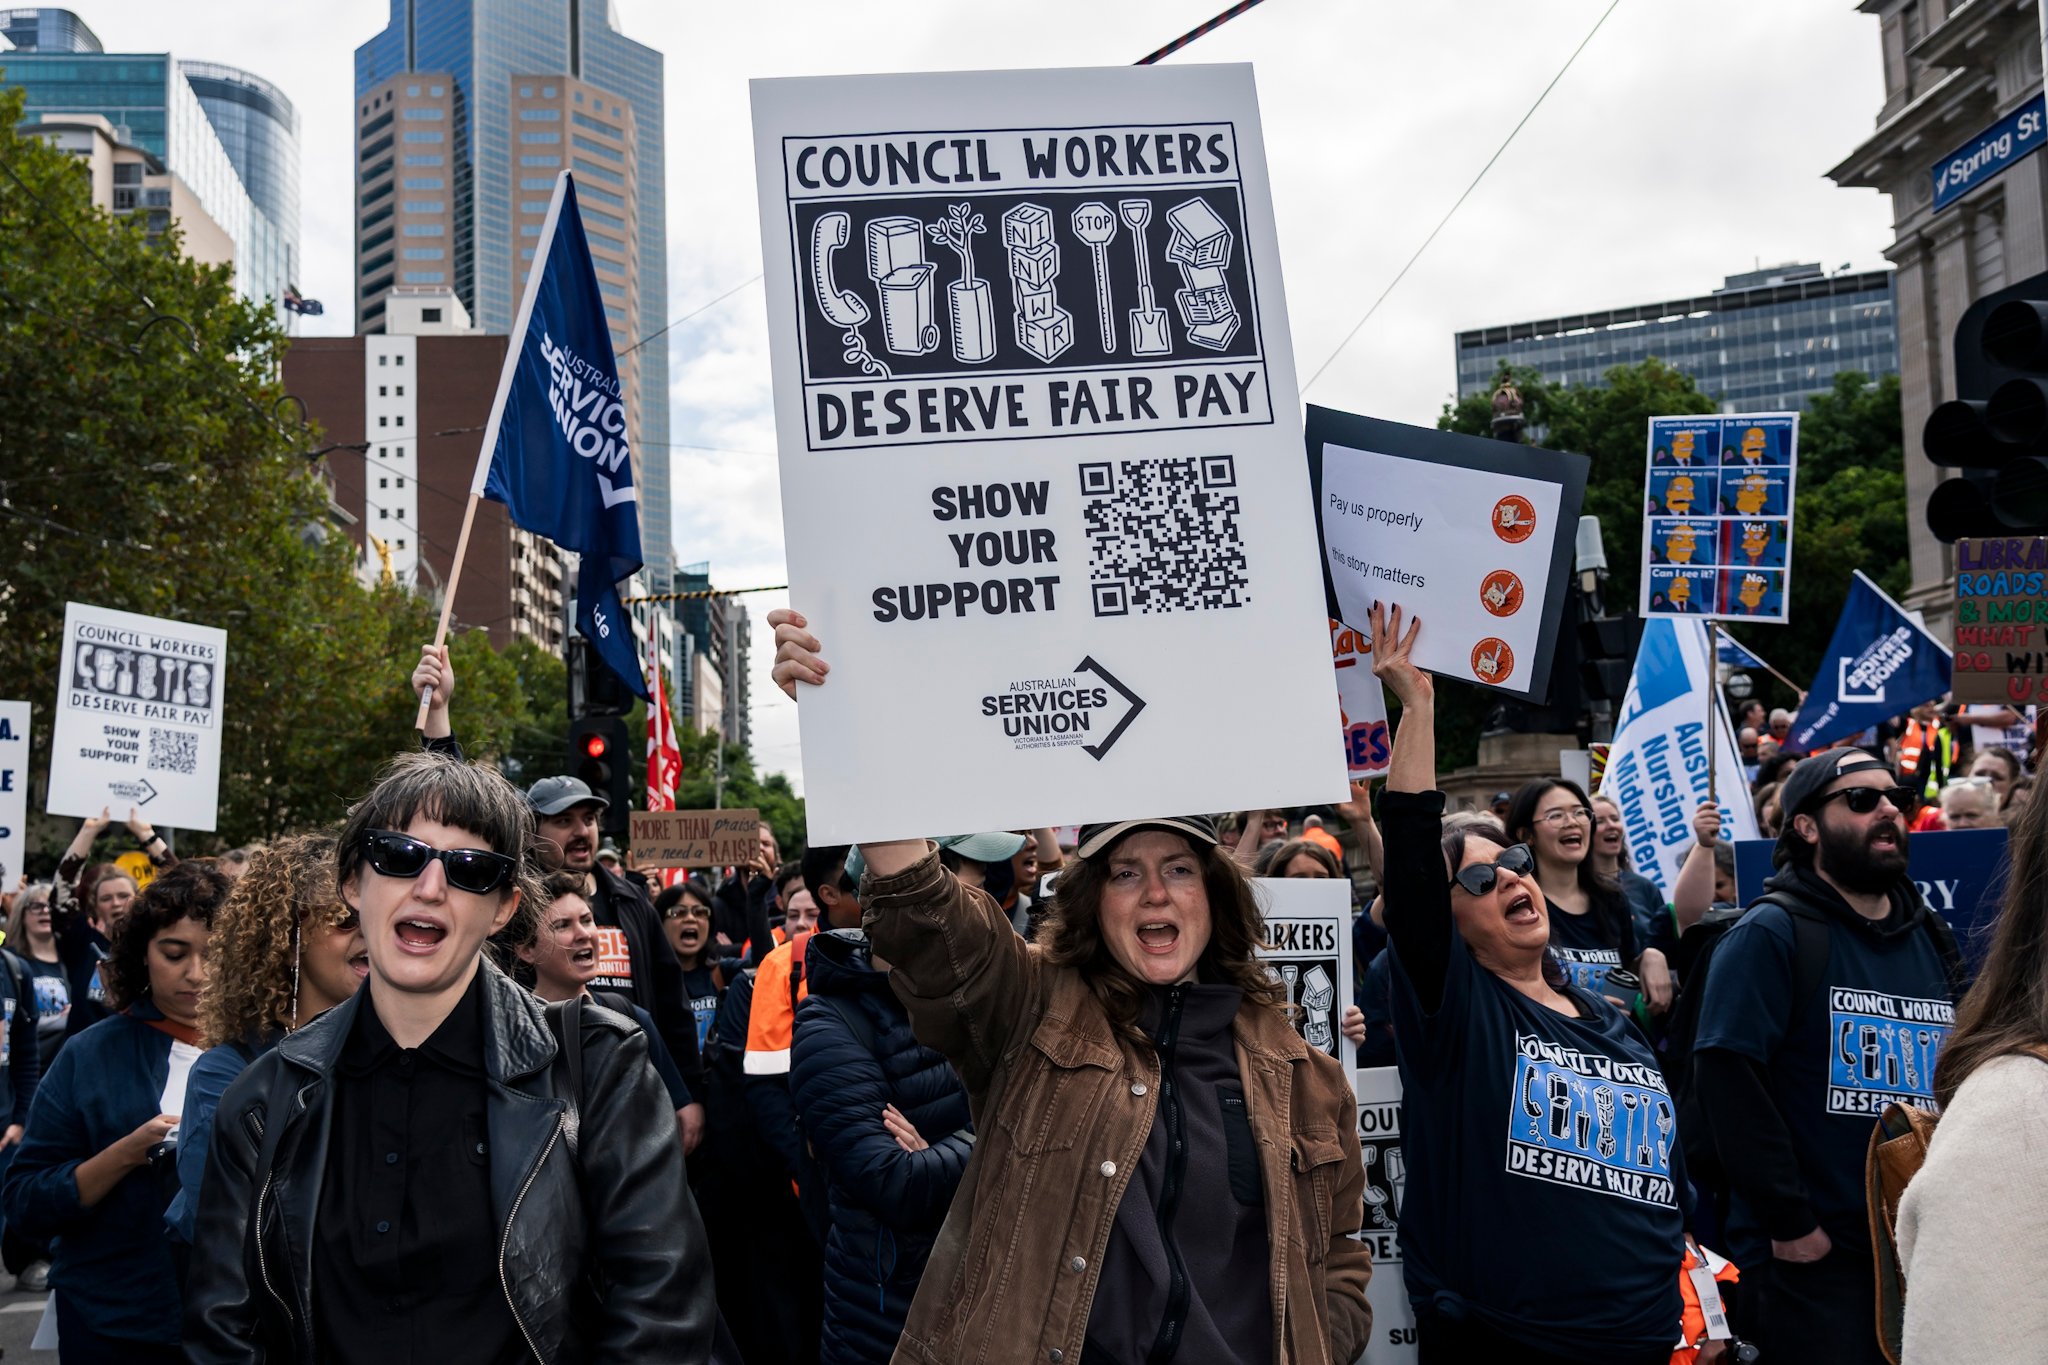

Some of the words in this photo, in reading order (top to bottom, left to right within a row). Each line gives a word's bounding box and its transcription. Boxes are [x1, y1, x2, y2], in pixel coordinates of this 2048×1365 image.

[796, 138, 1001, 190] COUNCIL
[1023, 132, 1230, 180] WORKERS
[1950, 131, 2012, 184] Spring
[2017, 110, 2042, 141] St
[1077, 215, 1111, 232] STOP
[816, 383, 1031, 442] DESERVE
[1049, 376, 1161, 428] FAIR
[1174, 371, 1258, 420] PAY
[931, 480, 1051, 522] SHOW
[1329, 493, 1349, 516] Pay
[1351, 502, 1364, 517] us
[1366, 506, 1424, 533] properly
[1742, 522, 1768, 533] Yes!
[948, 527, 1058, 568] YOUR
[1331, 546, 1346, 565] this
[1346, 555, 1370, 578] story
[1372, 564, 1425, 588] matters
[1652, 568, 1675, 579] Can
[1700, 568, 1715, 579] it?
[1746, 573, 1768, 584] No.
[872, 576, 1061, 623] SUPPORT
[1958, 600, 1981, 624] &
[1987, 599, 2048, 624] MOR
[593, 603, 610, 639] ide
[78, 625, 142, 648] COUNCIL
[150, 637, 215, 660] WORKERS
[1955, 625, 2037, 647] WHAT
[1956, 652, 1993, 673] DO
[2005, 650, 2048, 675] WI
[1009, 677, 1076, 693] AUSTRALIAN
[72, 693, 138, 715] DESERVE
[144, 704, 179, 721] FAIR
[183, 710, 210, 726] PAY
[981, 687, 1108, 717] SERVICES
[103, 725, 141, 739] SHOW
[1003, 711, 1090, 737] UNION
[1013, 735, 1044, 744] VICTORIAN
[1050, 732, 1084, 742] TASMANIAN
[79, 748, 139, 765] SUPPORT
[107, 737, 140, 751] YOUR
[1015, 740, 1051, 750] AUTHORITIES
[1056, 739, 1084, 747] SERVICES
[1641, 733, 1690, 847] Nursing
[632, 818, 671, 840] MORE
[675, 817, 710, 840] THAN
[711, 816, 758, 838] praise
[1615, 750, 1668, 889] Midwifery
[636, 846, 657, 858] we
[661, 842, 694, 859] need
[694, 848, 704, 859] a
[1833, 991, 1899, 1018] COUNCIL
[1901, 1000, 1956, 1023] WORKER
[1511, 1146, 1602, 1187] DESERVE
[1604, 1167, 1644, 1199] FAIR
[1647, 1178, 1675, 1204] PAY
